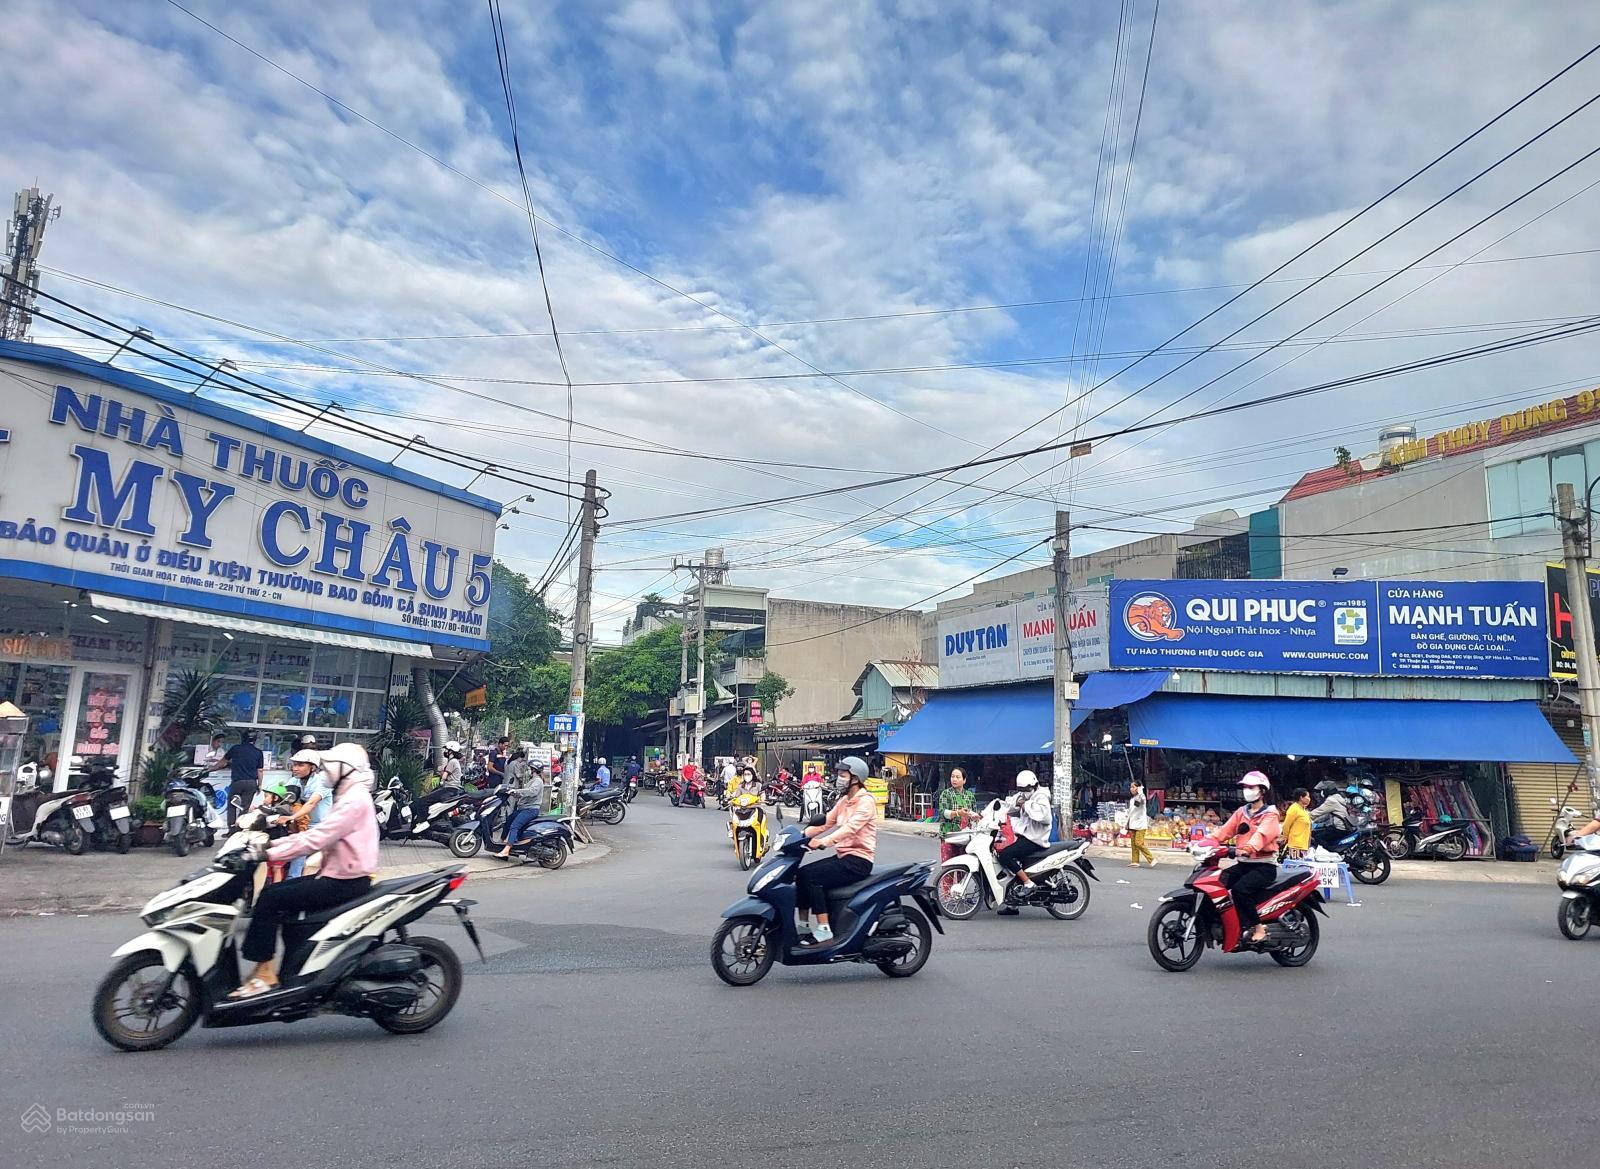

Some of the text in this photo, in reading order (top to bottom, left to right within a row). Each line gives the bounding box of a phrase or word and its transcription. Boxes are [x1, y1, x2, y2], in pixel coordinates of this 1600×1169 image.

[49, 384, 369, 509] NHÀ THUỐC
[62, 444, 493, 609] MY CHÂU 5
[65, 531, 129, 559] QUẢN
[208, 560, 252, 582] KIỆN
[328, 583, 358, 602] BAO
[418, 602, 447, 619] SINH
[132, 567, 153, 578] GIAN
[156, 570, 177, 583] HOẠT
[272, 591, 282, 600] CN
[1387, 587, 1444, 599] CỬA HÀNG
[1347, 599, 1367, 607] 1985
[1185, 598, 1316, 622] QUI PHUC
[1388, 600, 1538, 630] MẠNH TUẤN
[1187, 625, 1203, 635] Nội
[1205, 626, 1234, 638] Ngoại
[1236, 625, 1257, 635] Thất
[1260, 626, 1281, 636] Inox
[1290, 626, 1316, 637] Nhựa
[1411, 632, 1517, 643] BÀN GHẾ, GIƯỜNG, TỦ, NỆM,
[945, 624, 1008, 656] DUYTAN
[1417, 641, 1428, 650] ĐỒ
[1444, 643, 1466, 651] DỤNG
[1468, 643, 1484, 651] CÁC
[1126, 647, 1264, 658] TỰ HÀO THƯƠNG HIỆU QUỐC GIA
[1282, 651, 1369, 661] WWW.QUIPHUC.COM
[554, 722, 572, 731] DA 6
